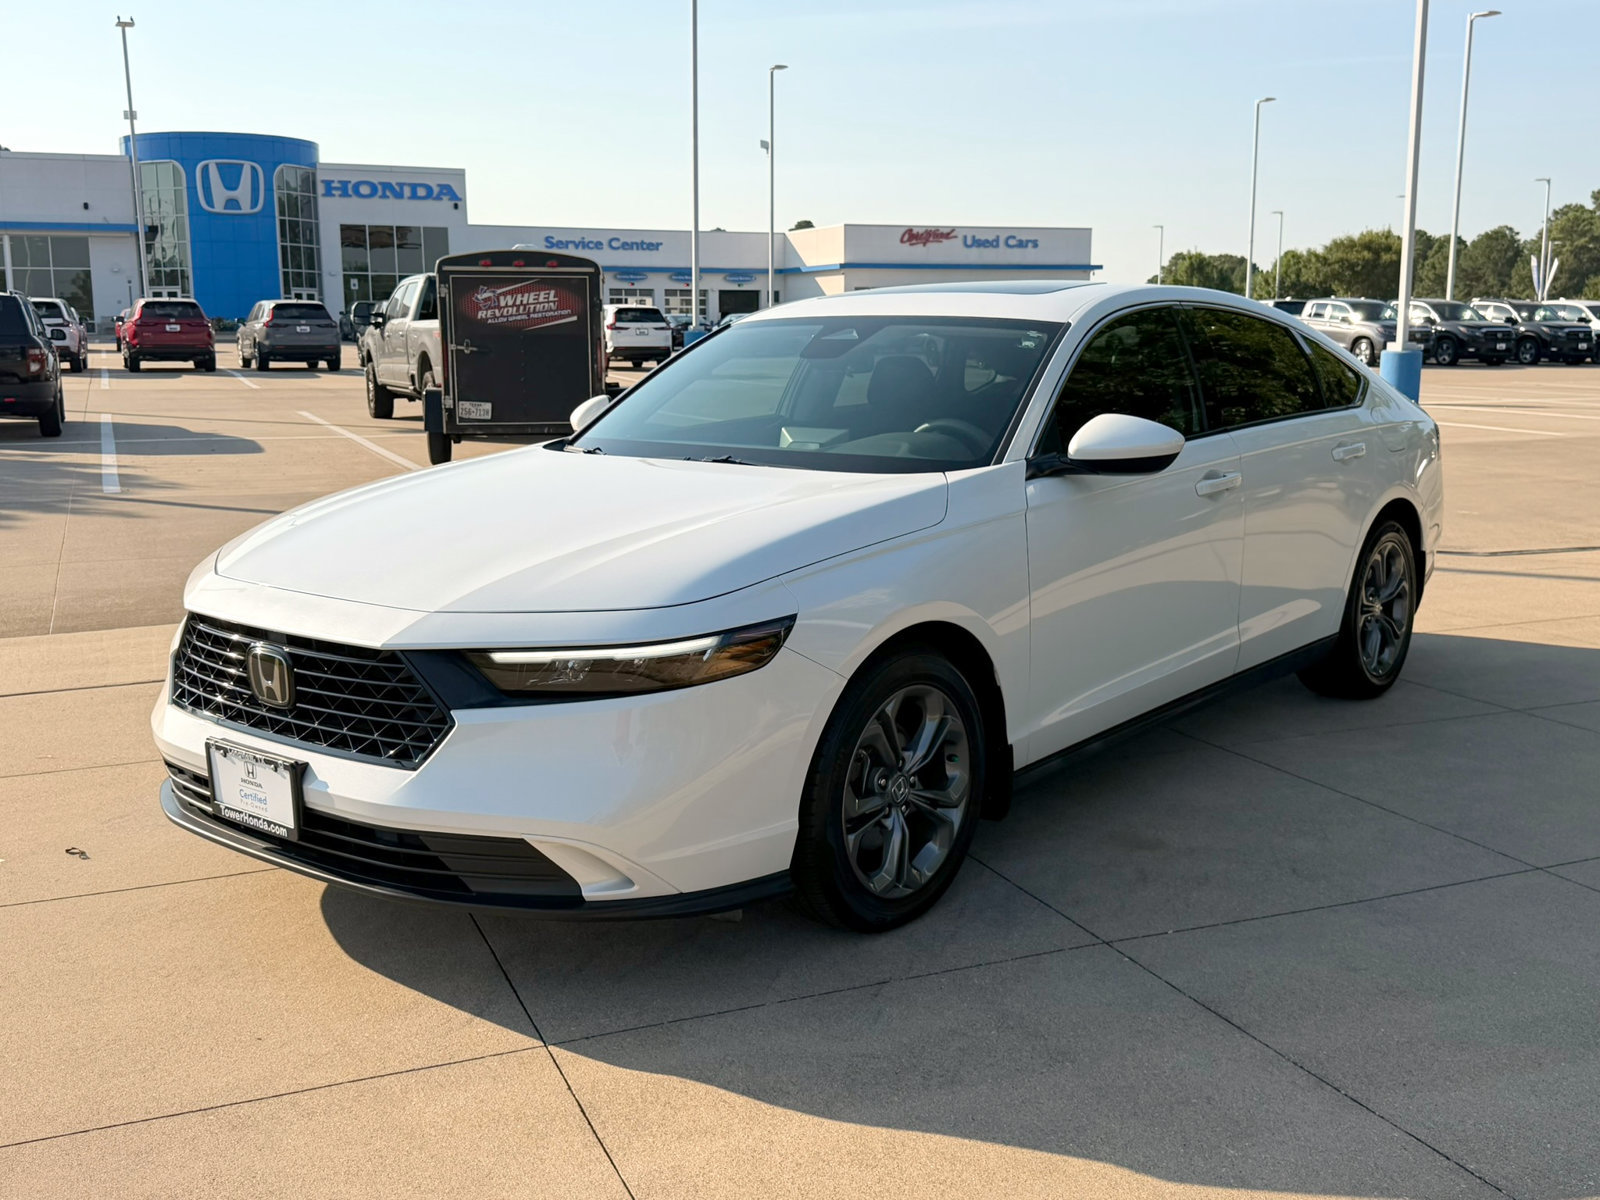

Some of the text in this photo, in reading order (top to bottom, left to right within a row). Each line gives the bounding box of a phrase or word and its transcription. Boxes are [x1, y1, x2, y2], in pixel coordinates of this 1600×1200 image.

[321, 179, 462, 201] HONDA
[544, 235, 663, 251] Service Center
[962, 234, 1000, 249] Used
[1004, 235, 1039, 249] Cars
[500, 290, 558, 307] WHEEL
[477, 302, 558, 320] REVOLUTION
[530, 309, 571, 319] RESTORATION
[240, 777, 263, 789] HONDA
[239, 788, 267, 806] Certified
[220, 805, 288, 837] TowerHonda.com
